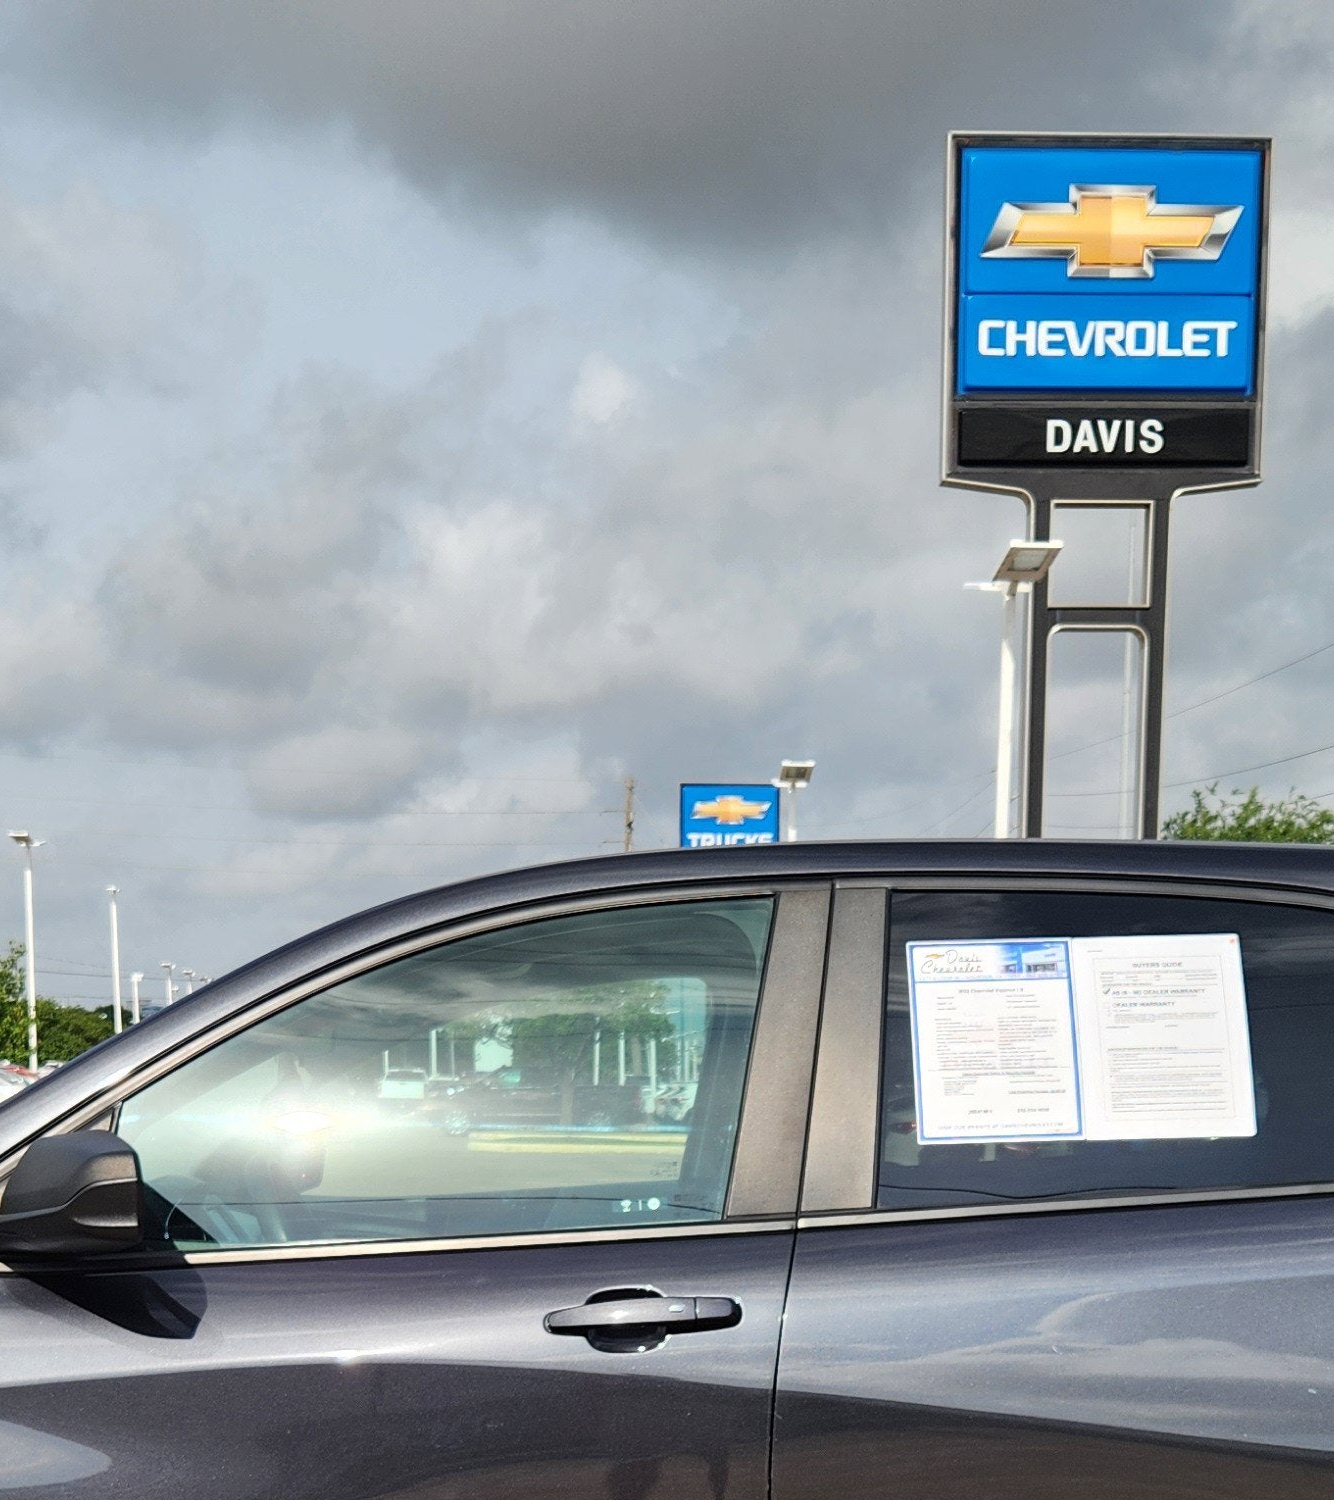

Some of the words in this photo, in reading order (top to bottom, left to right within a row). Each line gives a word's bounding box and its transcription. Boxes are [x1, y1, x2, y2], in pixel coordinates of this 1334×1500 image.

[978, 319, 1238, 358] CHEVROLET
[1045, 418, 1165, 454] DAVIS
[686, 832, 774, 847] TRUCKS
